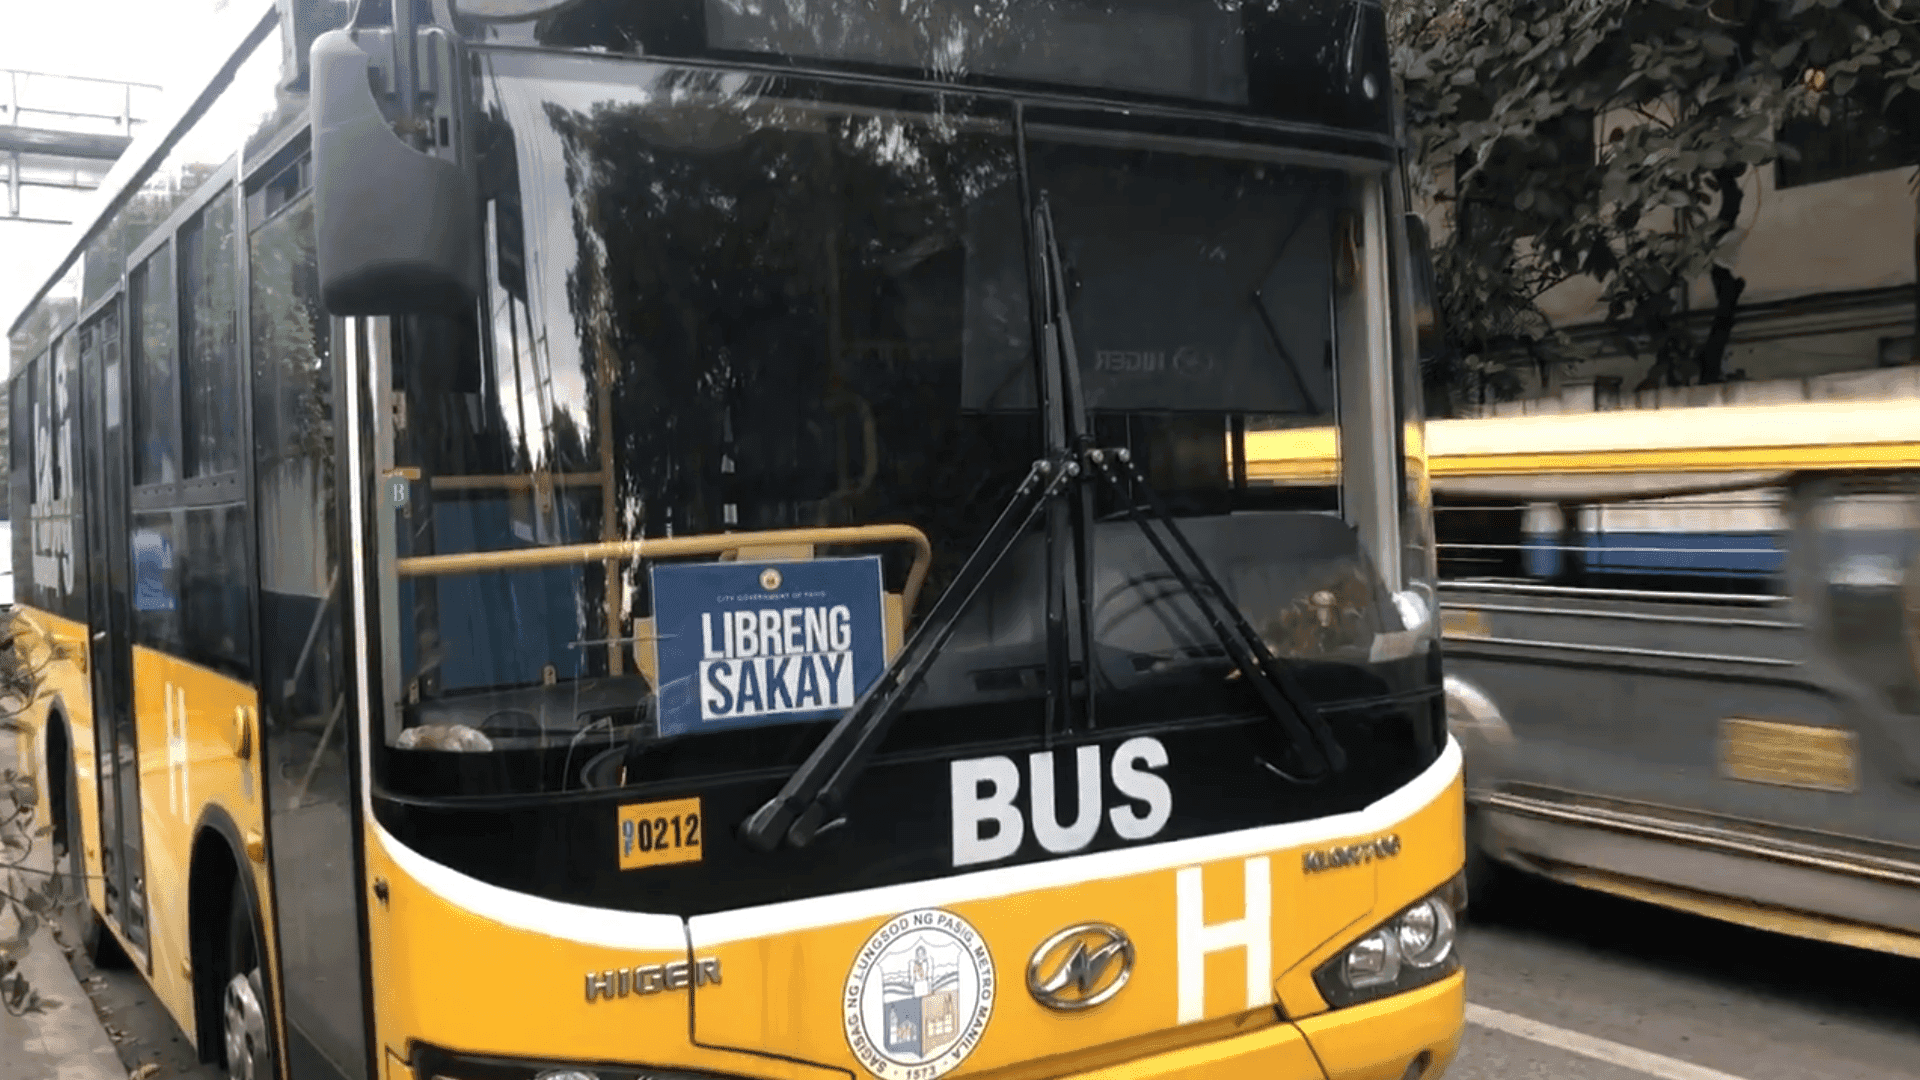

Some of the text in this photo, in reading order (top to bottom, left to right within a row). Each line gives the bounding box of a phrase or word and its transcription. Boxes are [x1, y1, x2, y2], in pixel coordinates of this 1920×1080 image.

[701, 604, 852, 660] LIBRENG
[706, 652, 845, 716] SAKAY
[950, 736, 1173, 868] BUS
[638, 813, 701, 852] 0212
[913, 912, 934, 926] NG
[1176, 855, 1273, 1026] H
[853, 917, 910, 980] LUNGSOD
[973, 946, 994, 1001] METRO
[585, 957, 723, 1005] HIGER
[847, 984, 860, 1009] NG
[848, 1014, 888, 1074] SAGISAG
[950, 1005, 989, 1061] MANILA
